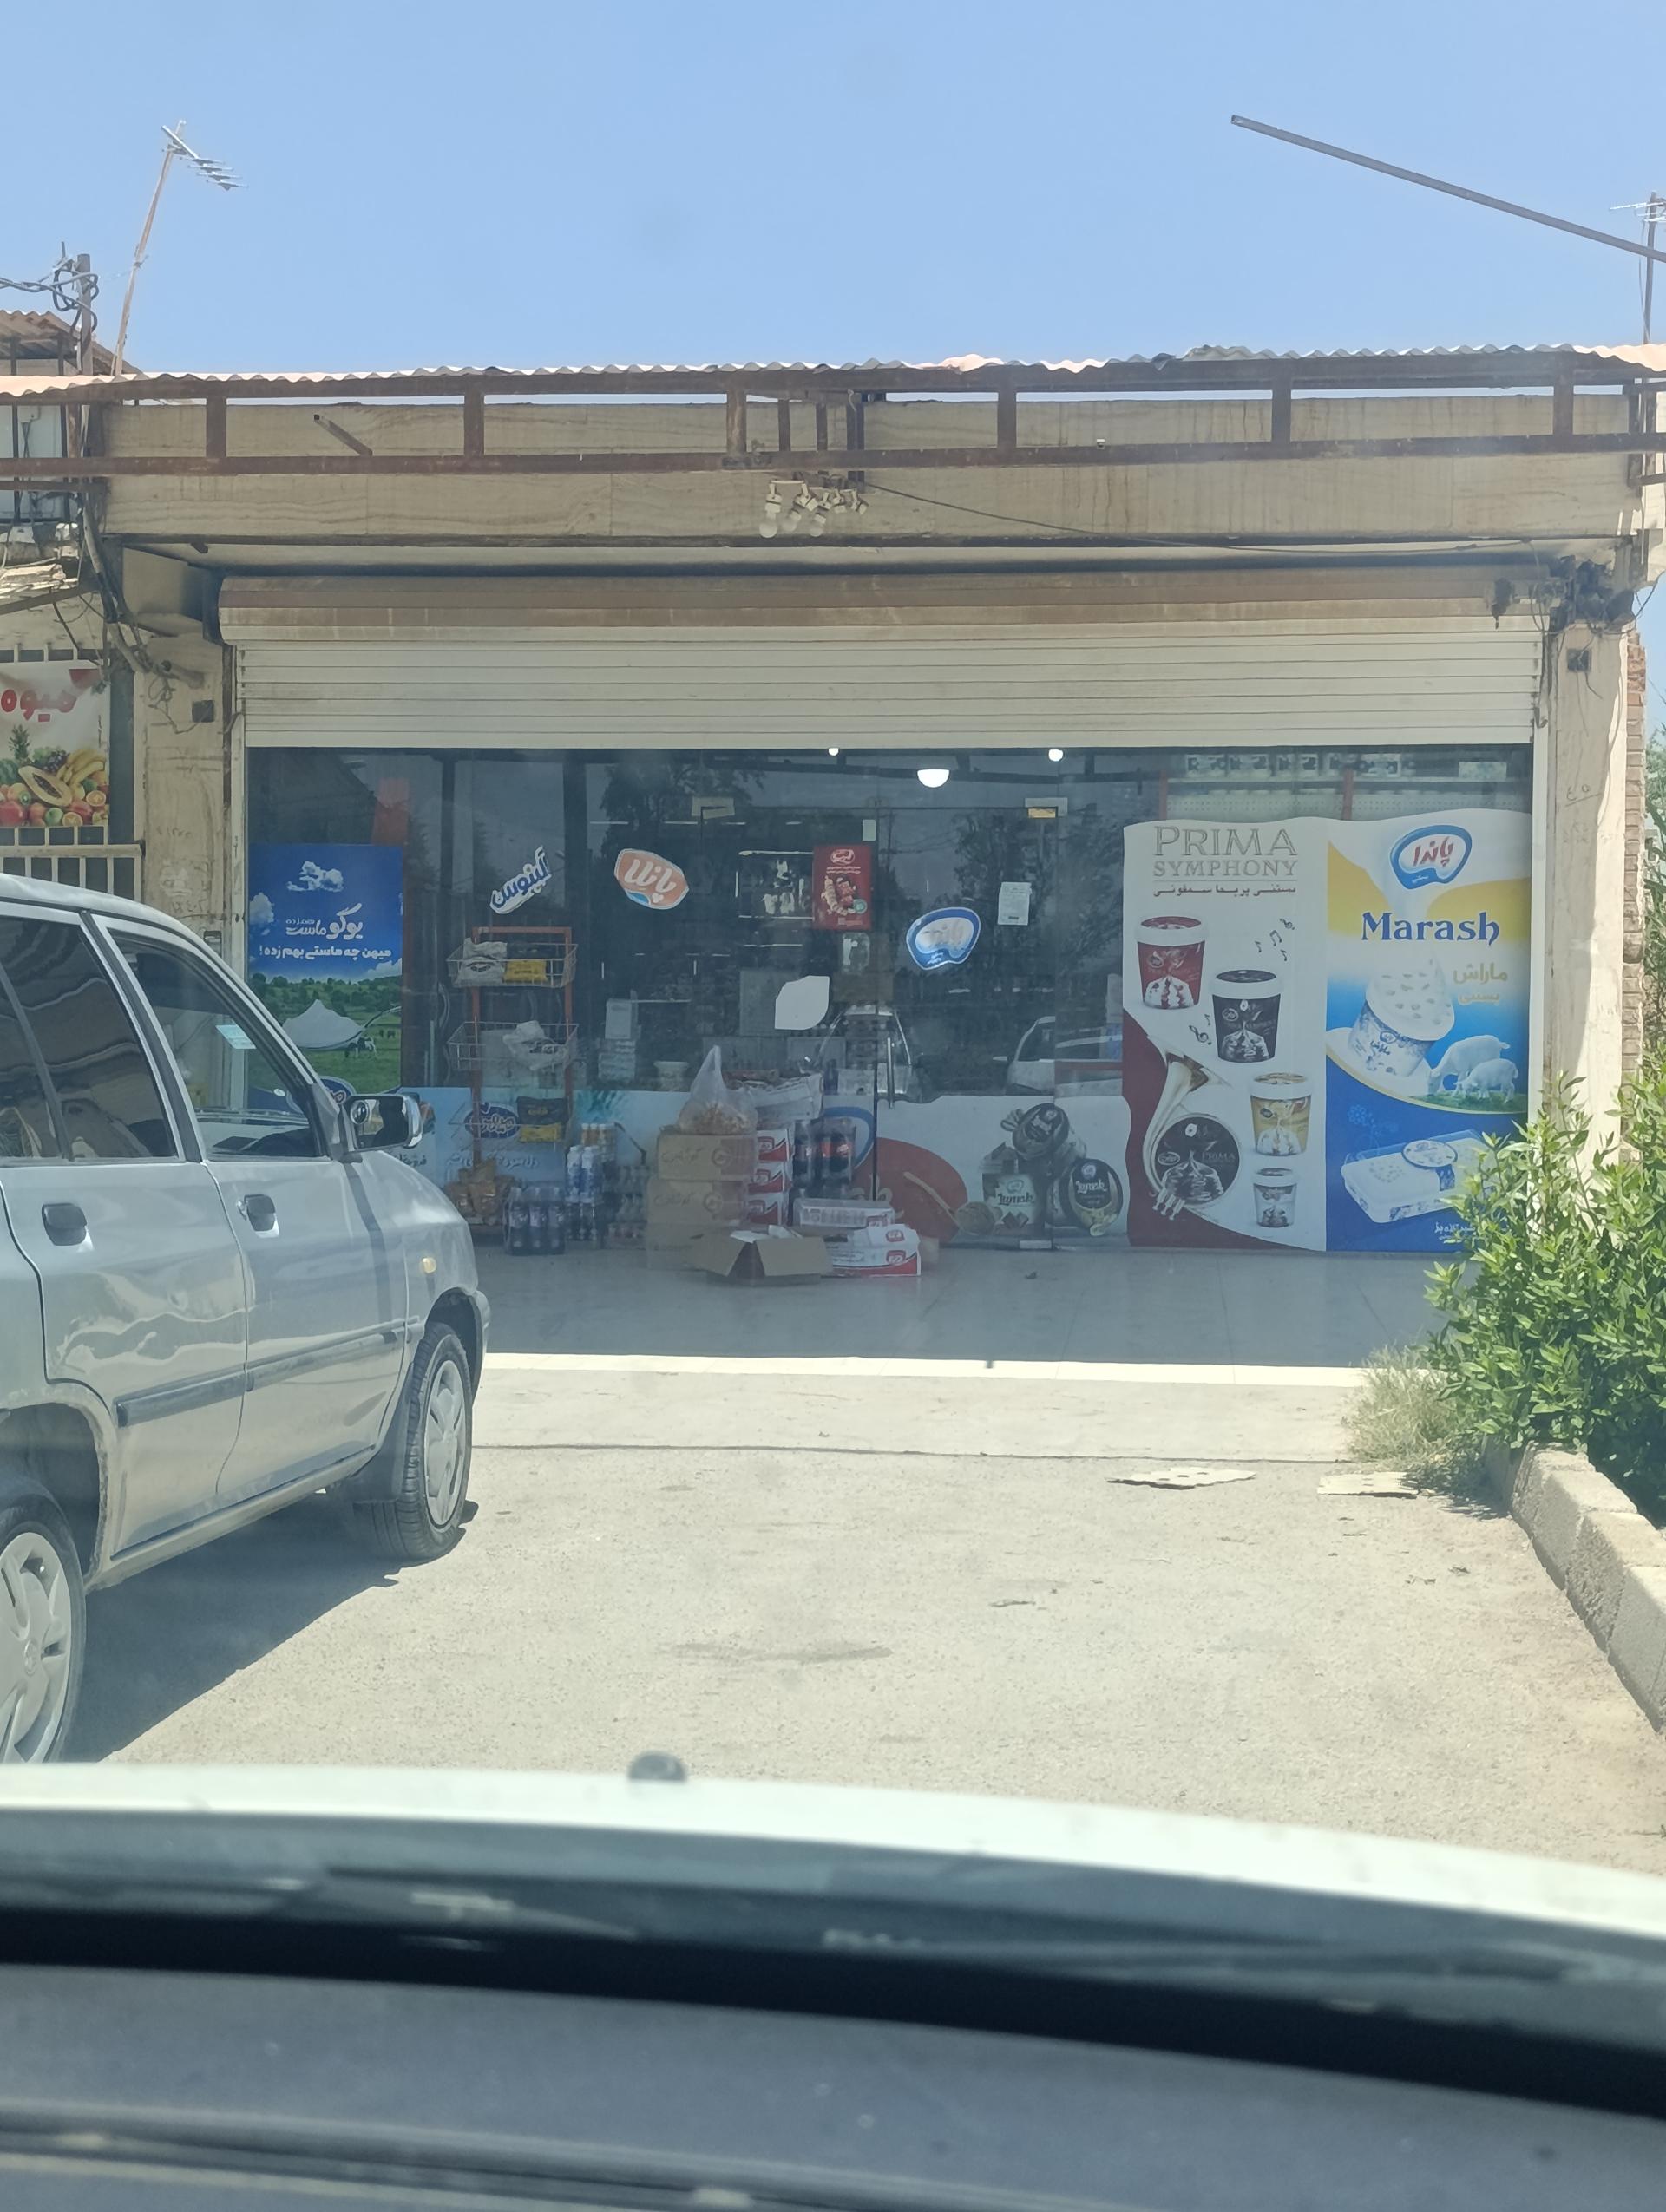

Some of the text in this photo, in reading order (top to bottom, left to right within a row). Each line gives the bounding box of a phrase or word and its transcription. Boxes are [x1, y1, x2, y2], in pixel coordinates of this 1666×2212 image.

[1154, 826, 1298, 856] PRIMA
[1413, 835, 1454, 868] پاندا
[1152, 859, 1298, 877] SYMPHONY
[1153, 883, 1296, 897] بستنی پریما سمفونی
[1361, 911, 1500, 946] Marash
[362, 947, 392, 959] میهن
[1453, 962, 1508, 985] ماراش
